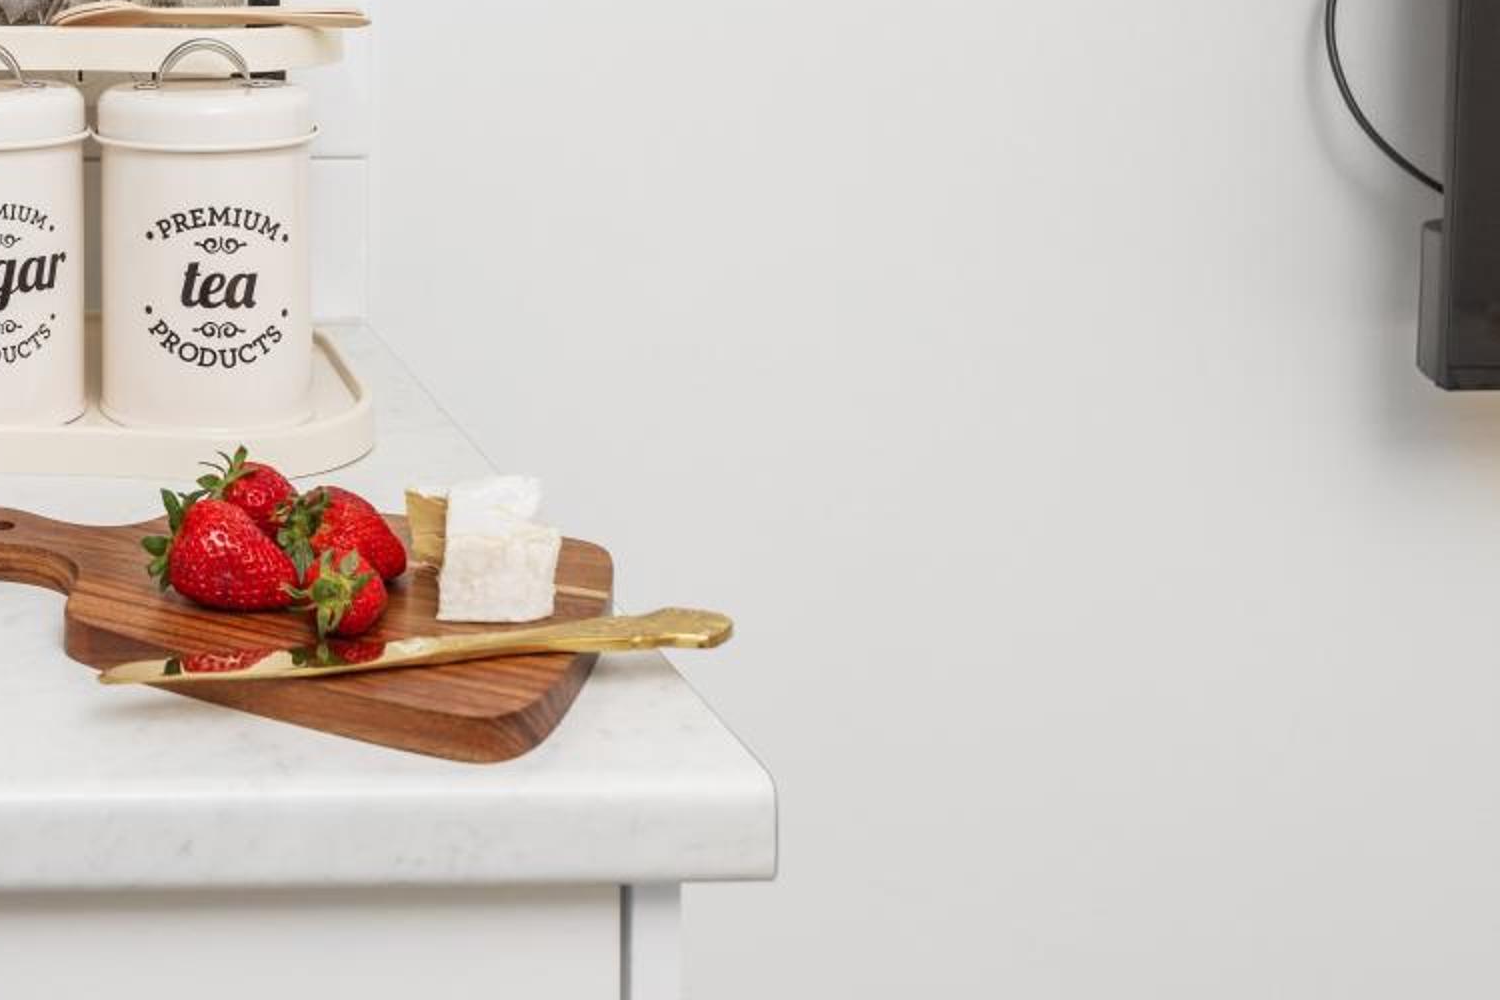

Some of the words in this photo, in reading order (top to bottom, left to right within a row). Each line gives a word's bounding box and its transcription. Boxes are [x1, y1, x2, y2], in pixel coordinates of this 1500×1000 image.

[156, 206, 281, 241] PREMIUM
[181, 261, 258, 309] tea
[148, 319, 282, 369] PRODUCTS
